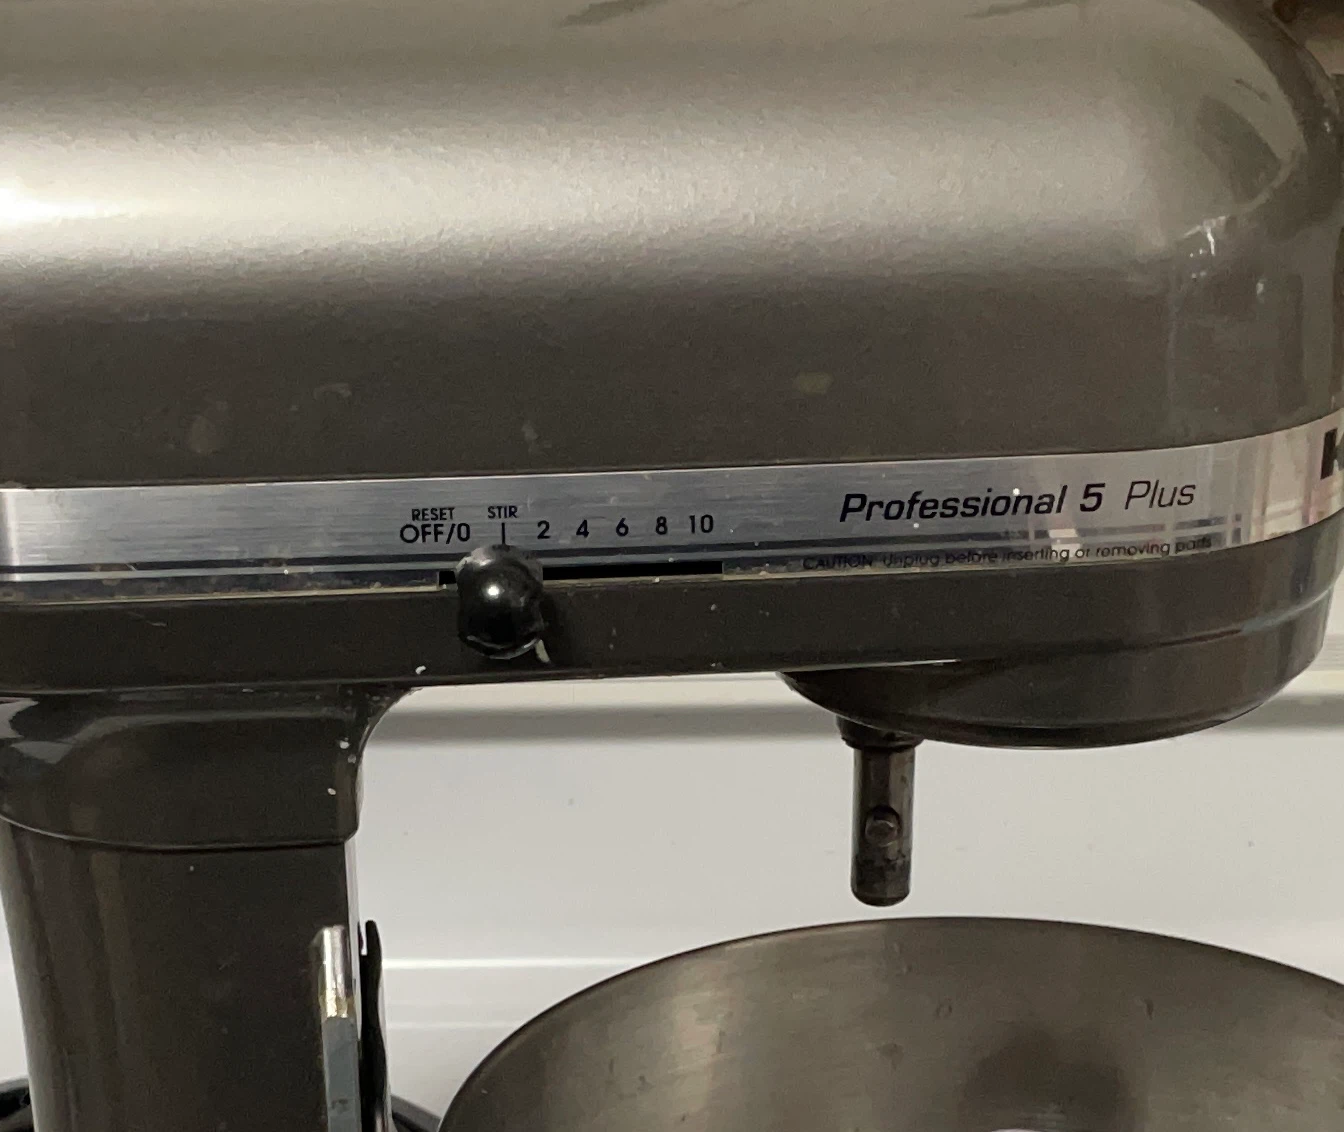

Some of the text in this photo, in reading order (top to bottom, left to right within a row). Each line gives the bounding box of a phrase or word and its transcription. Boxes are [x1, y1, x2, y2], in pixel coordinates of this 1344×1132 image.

[411, 505, 518, 522] RESET STIR
[839, 479, 1197, 523] Professional 5 Plus
[536, 519, 551, 540] 2
[575, 519, 590, 538] 4
[615, 517, 630, 537] 6
[656, 516, 668, 535] 8
[688, 514, 714, 534] 10
[882, 552, 940, 569] Unplug
[945, 550, 998, 565] before
[1074, 547, 1090, 558] or
[1095, 541, 1171, 558] removing
[1175, 535, 1212, 554] parts
